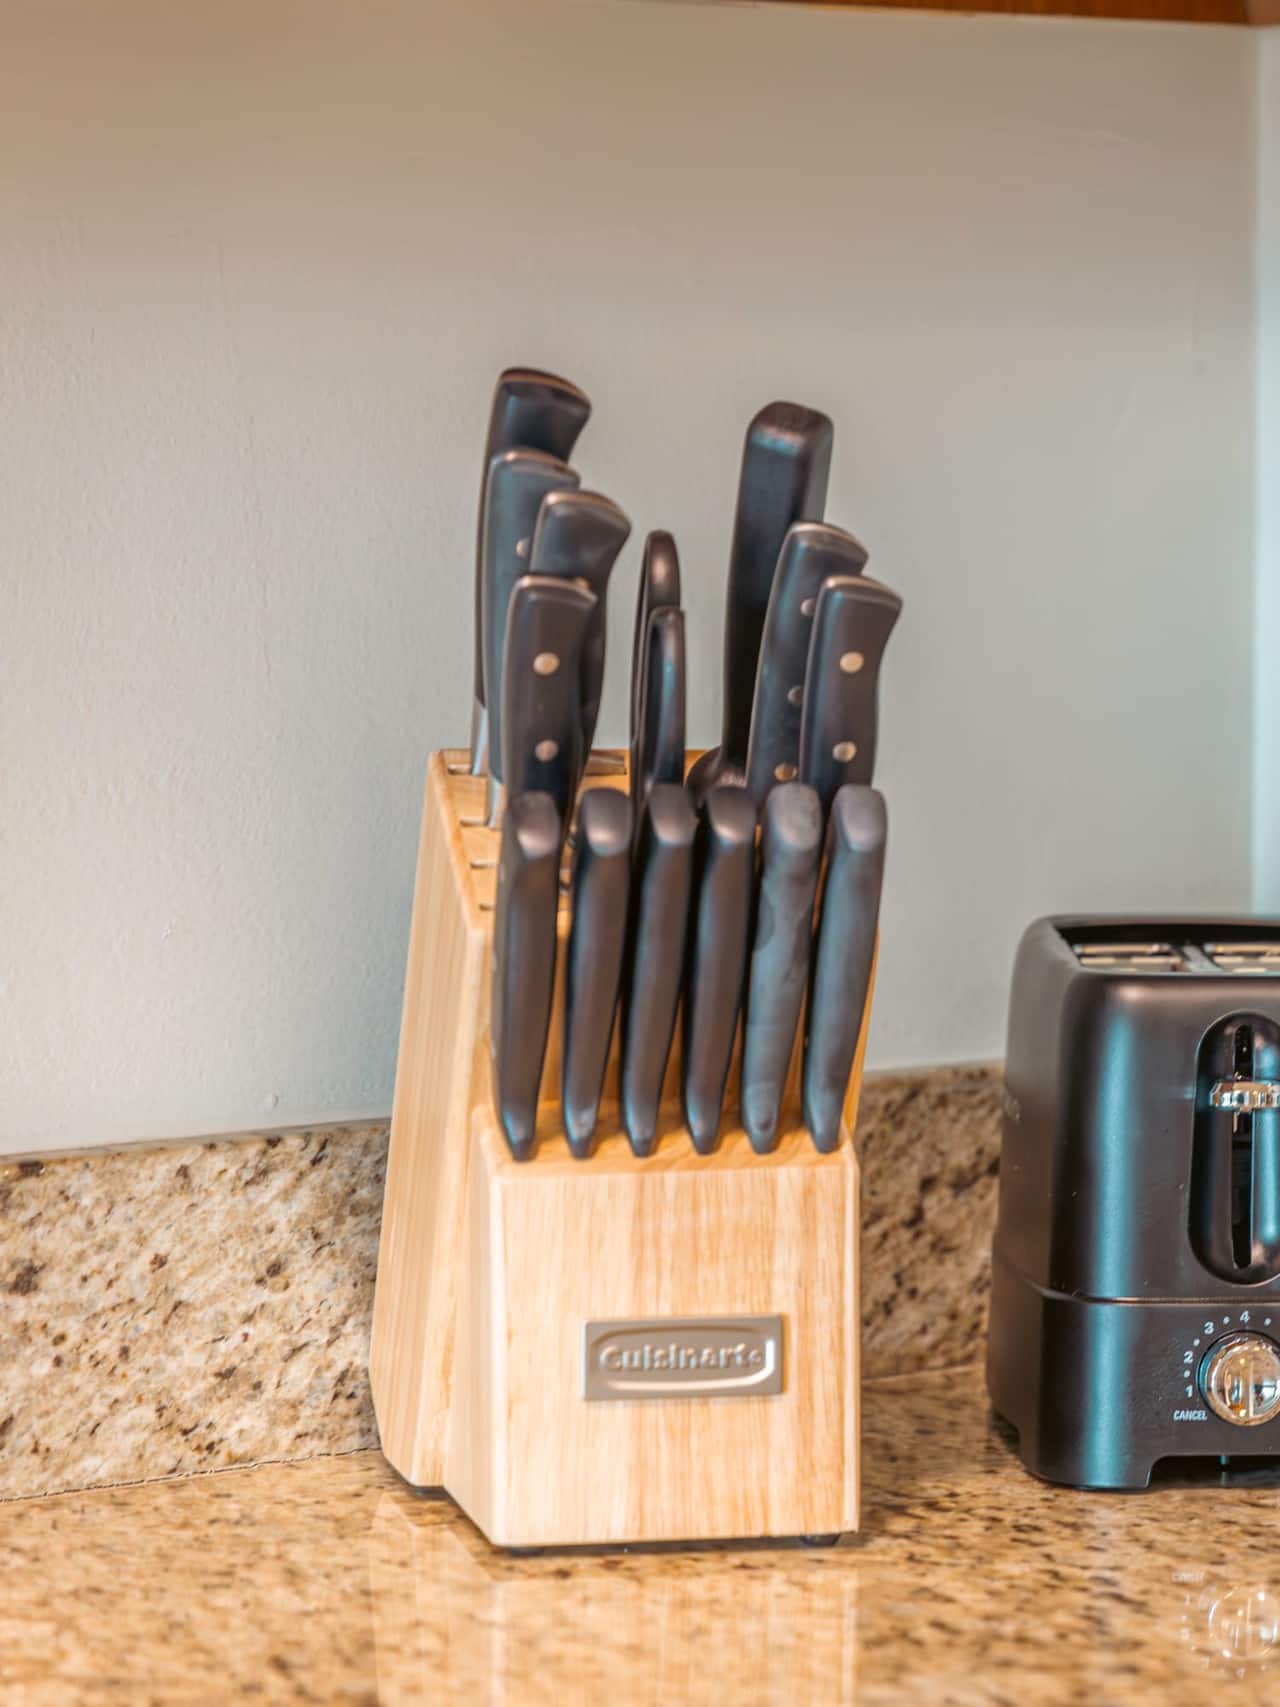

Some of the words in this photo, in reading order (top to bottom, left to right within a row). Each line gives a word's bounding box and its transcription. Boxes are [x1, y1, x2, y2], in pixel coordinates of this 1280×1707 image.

[1239, 1311, 1250, 1323] 4
[1203, 1321, 1215, 1335] 3
[1183, 1351, 1194, 1364] 2
[1185, 1385, 1193, 1398] 1
[1173, 1410, 1208, 1421] CANCEL
